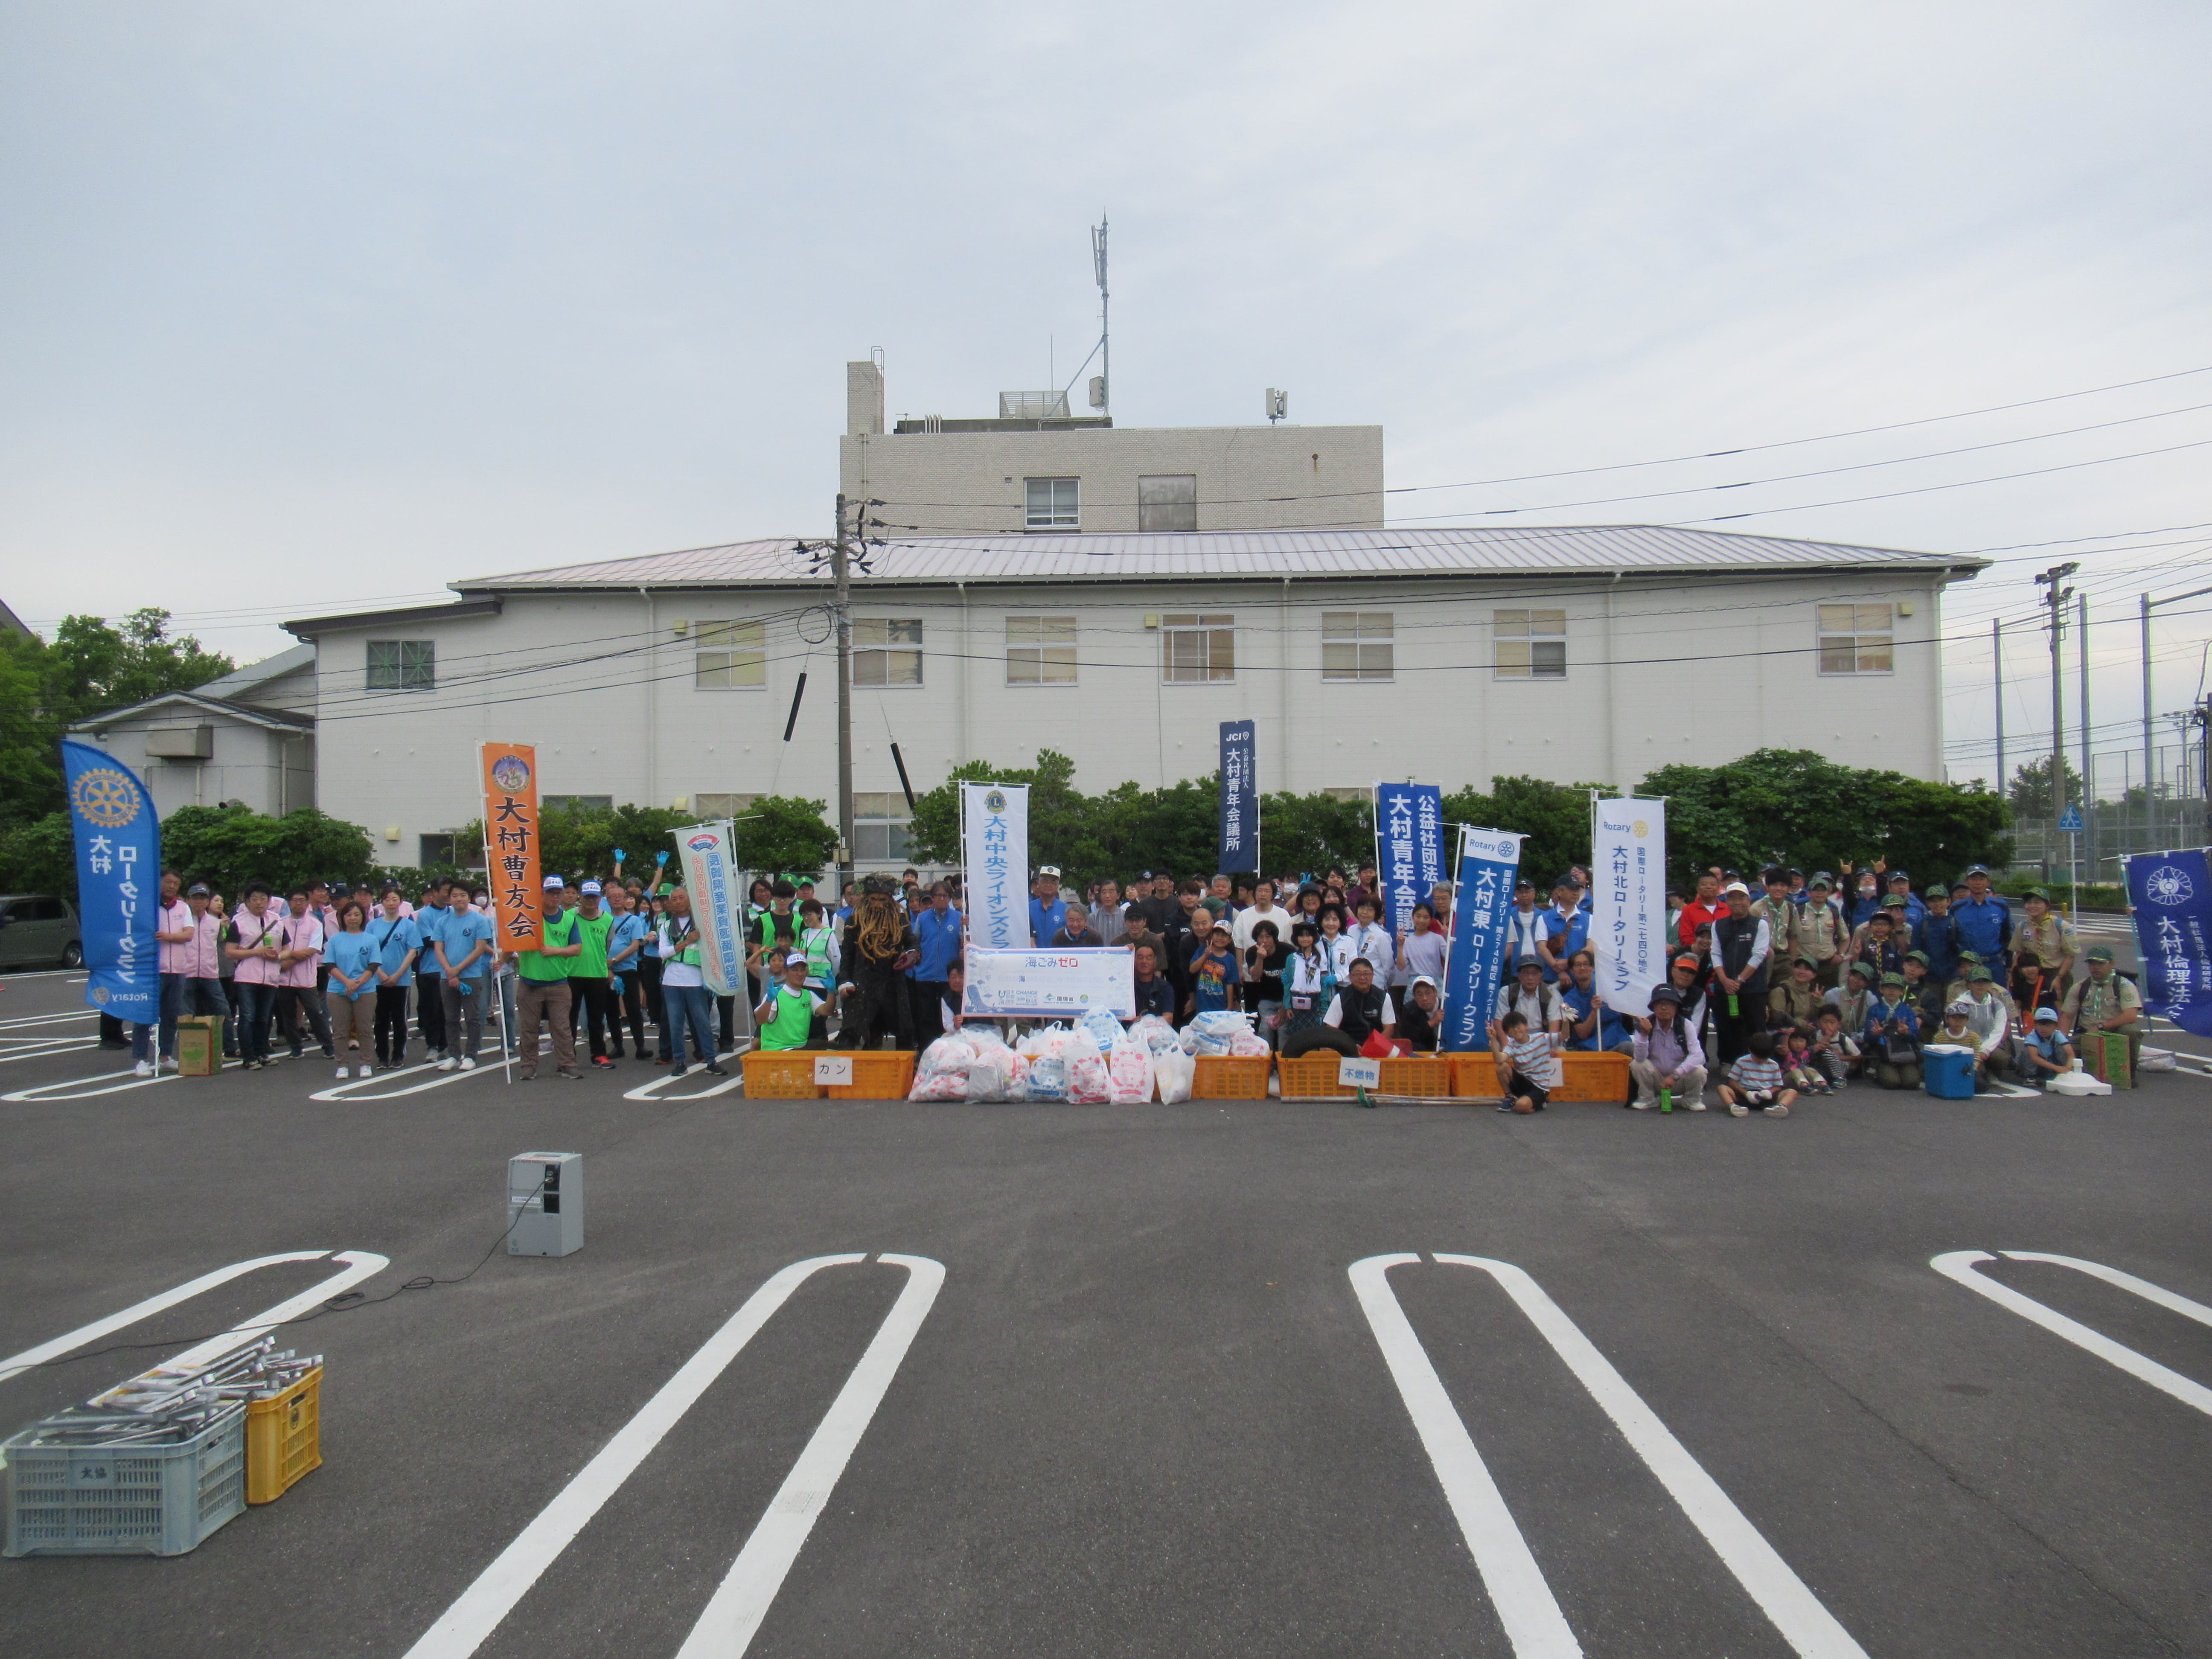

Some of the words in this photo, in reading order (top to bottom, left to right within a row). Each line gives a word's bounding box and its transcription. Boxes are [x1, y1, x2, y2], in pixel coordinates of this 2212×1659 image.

[1226, 733, 1241, 742] JCI
[1225, 748, 1241, 852] 大村青年会議所
[1604, 821, 1630, 833] Rotary
[1470, 839, 1496, 852] Rotary
[495, 796, 538, 938] 大村曹友会
[1388, 793, 1417, 937] 大村青年会議
[1472, 867, 1497, 930] 大村東
[1025, 956, 1078, 968] 海ごみゼロ
[1459, 934, 1484, 1045] ロータリークラブ
[819, 1064, 846, 1075] カン
[1345, 1068, 1375, 1081] 不燃物
